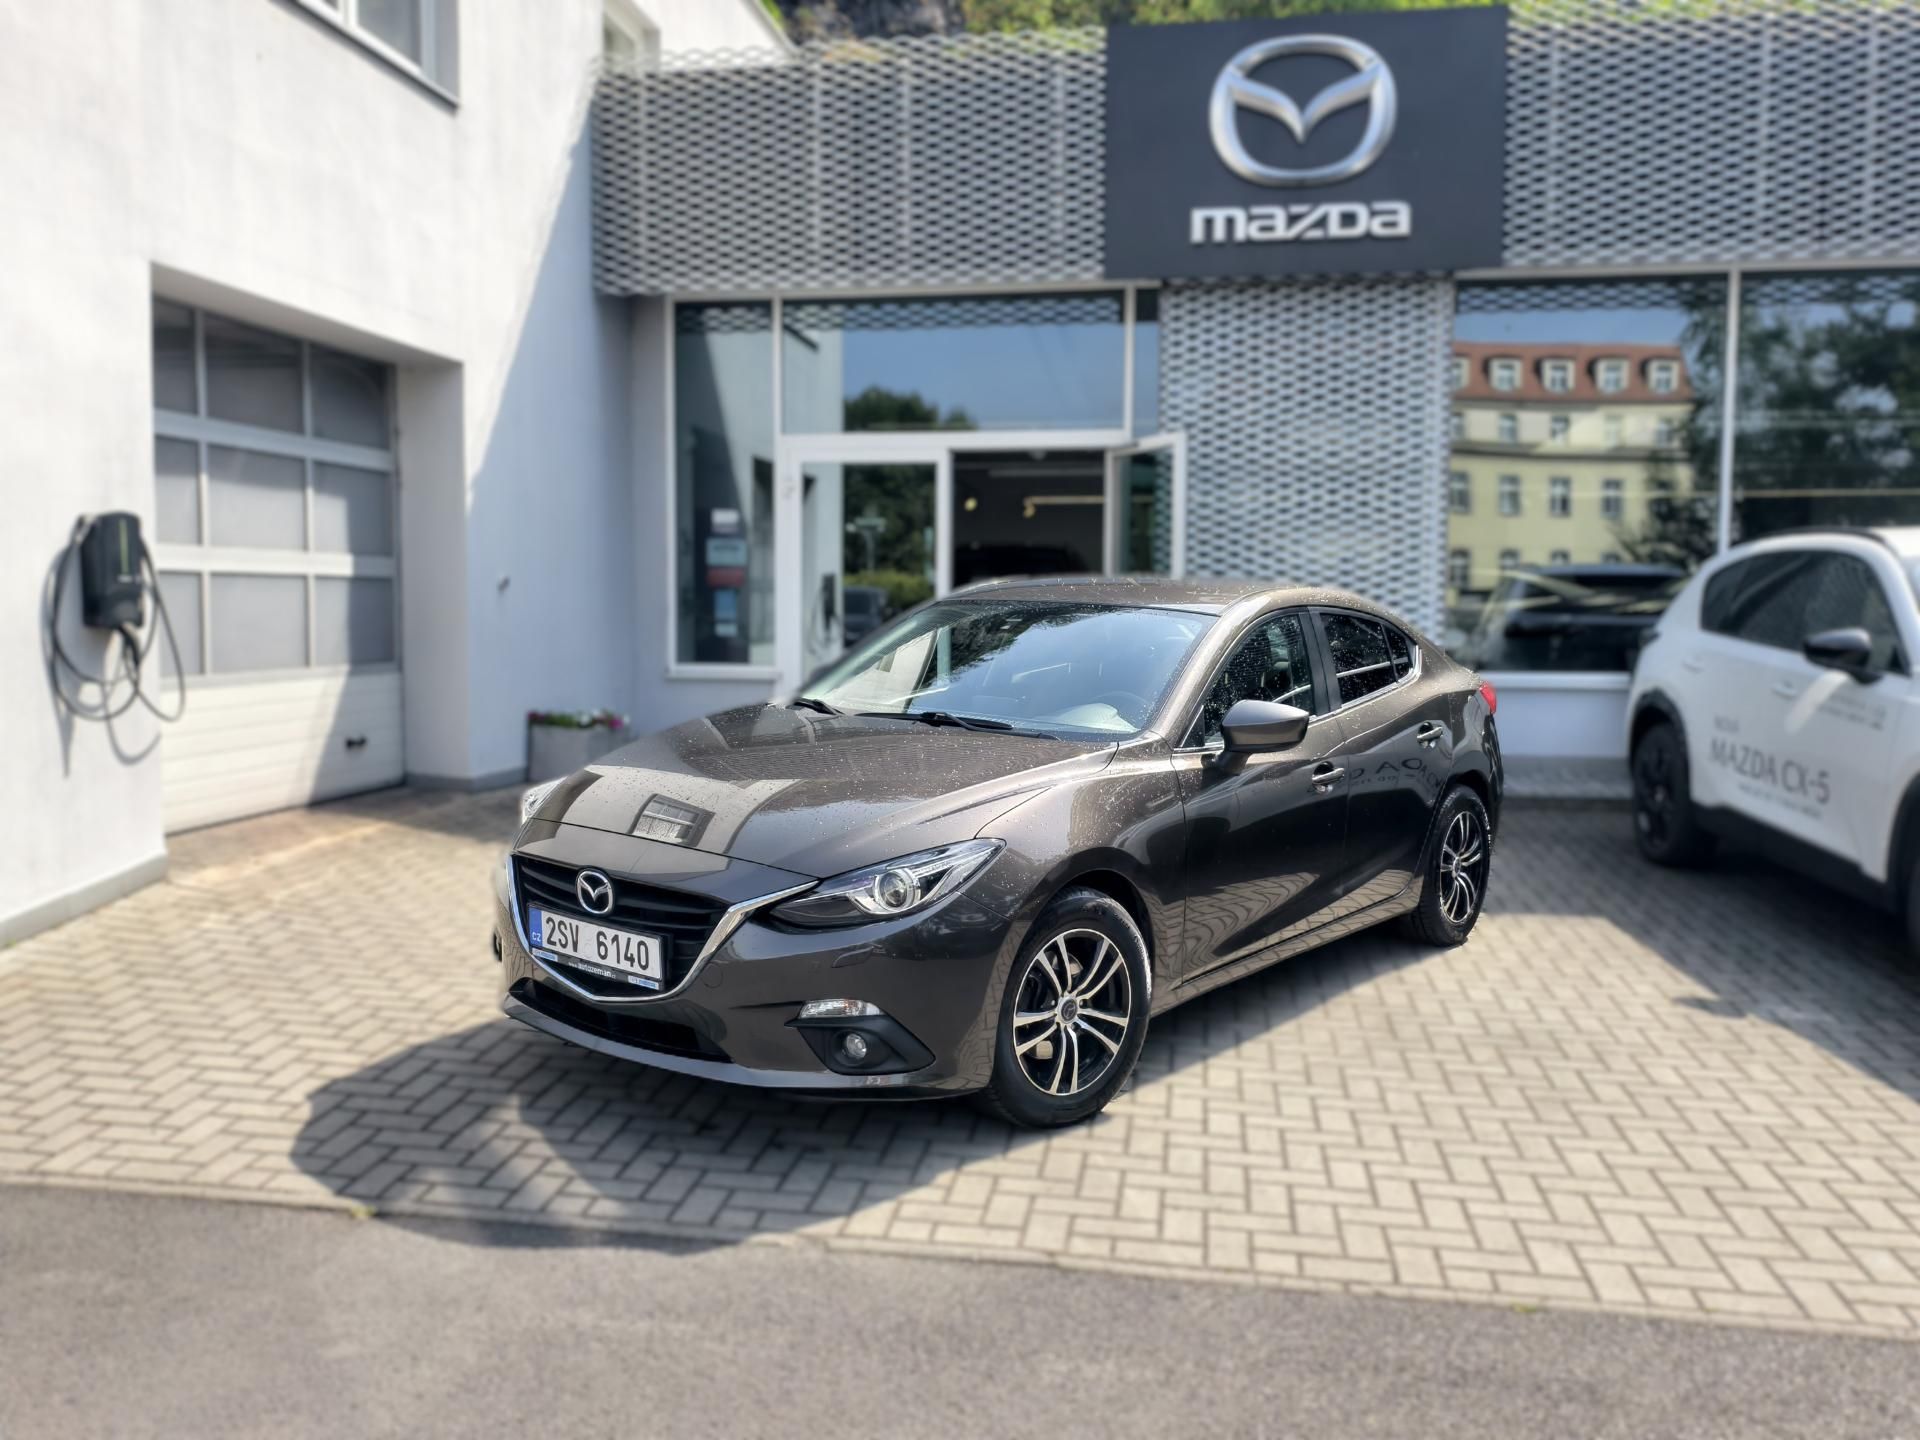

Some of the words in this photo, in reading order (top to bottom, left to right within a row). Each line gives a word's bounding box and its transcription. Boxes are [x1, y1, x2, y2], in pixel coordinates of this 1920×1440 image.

[1710, 738, 1778, 784] MAZDA
[1782, 760, 1830, 804] CX-5
[531, 932, 541, 942] CZ
[546, 917, 579, 952] 2SV
[596, 931, 649, 970] 6140
